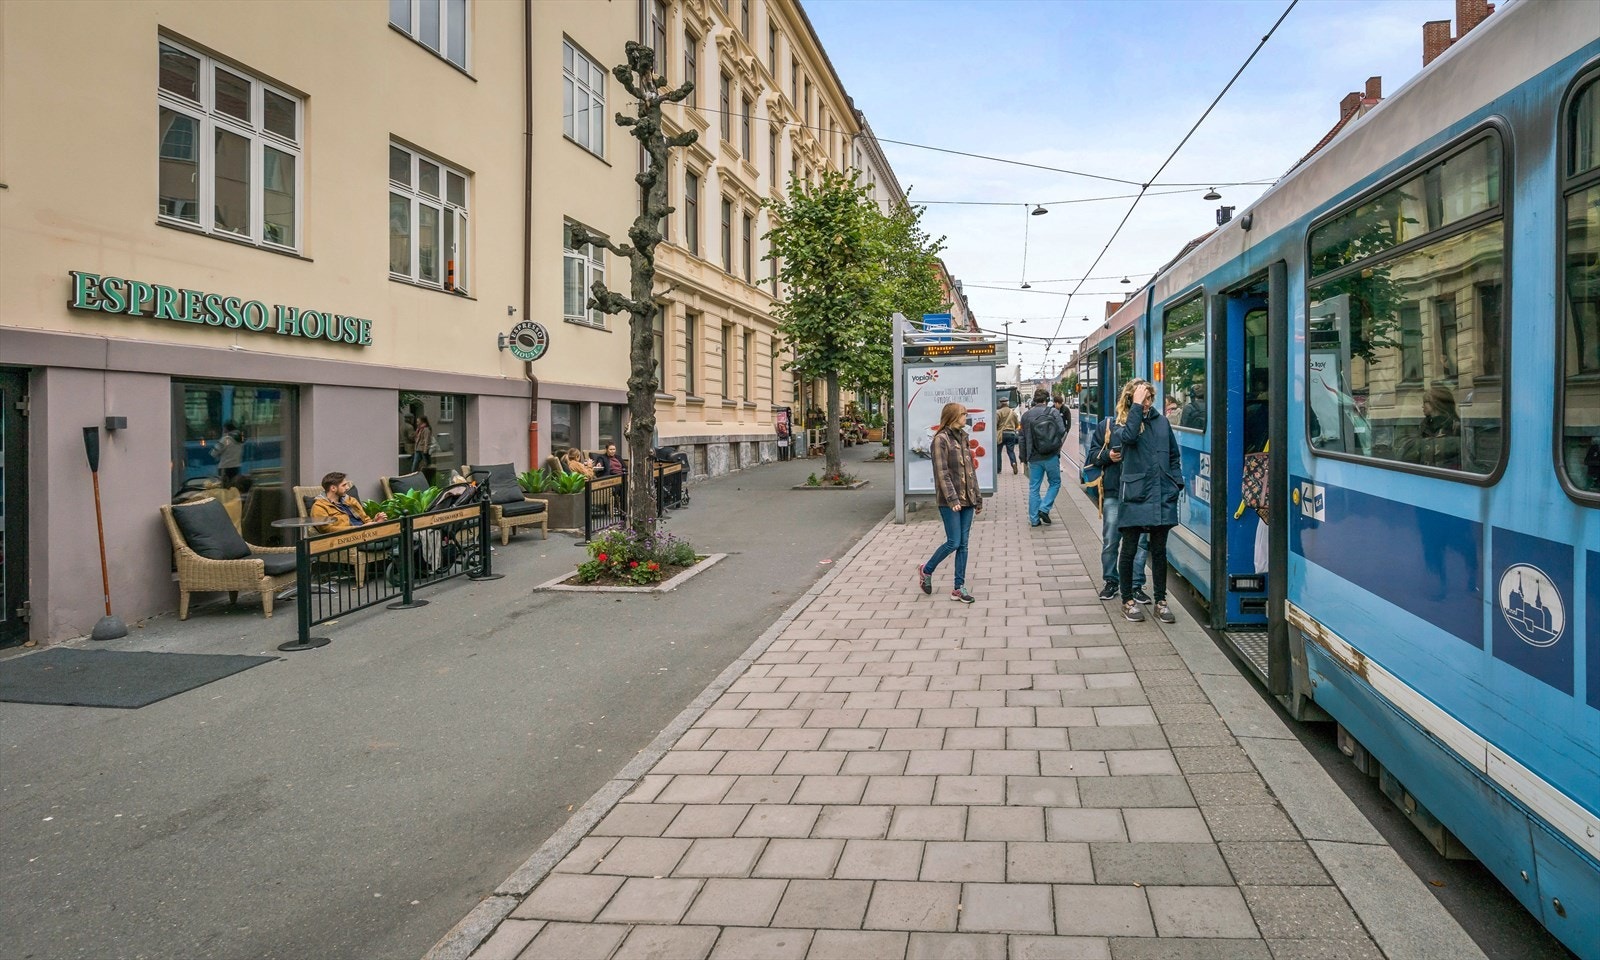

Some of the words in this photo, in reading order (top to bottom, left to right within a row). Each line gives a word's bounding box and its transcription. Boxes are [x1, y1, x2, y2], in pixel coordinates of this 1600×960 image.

[70, 271, 270, 331] ESPRESSO
[275, 304, 373, 346] HOUSE
[511, 322, 543, 338] ESPRESSO
[514, 348, 540, 359] HOUSE
